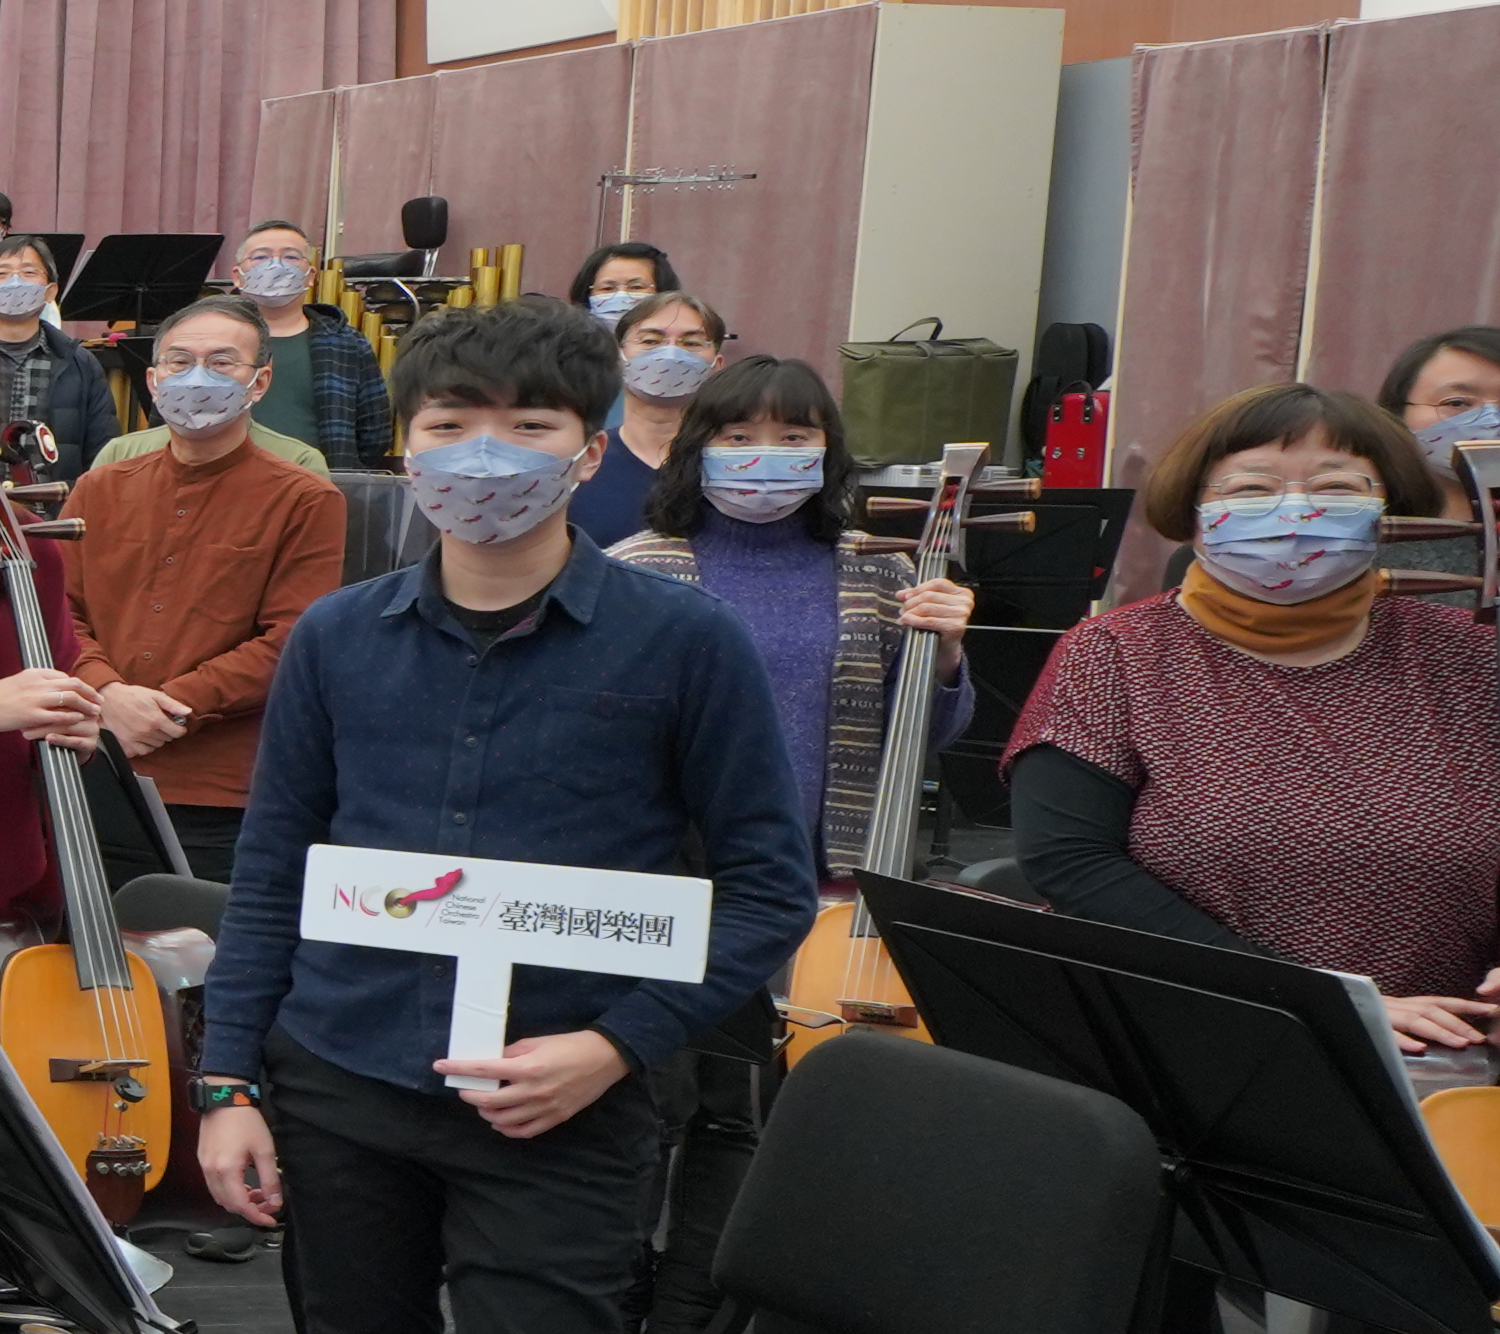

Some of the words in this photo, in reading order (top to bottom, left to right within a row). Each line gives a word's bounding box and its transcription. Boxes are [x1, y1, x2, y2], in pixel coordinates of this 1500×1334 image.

[452, 894, 486, 904] National
[445, 901, 477, 911] Chinese
[441, 908, 480, 919] Orchestra
[438, 916, 466, 926] Taiwan
[498, 899, 675, 948] 臺灣國樂團
